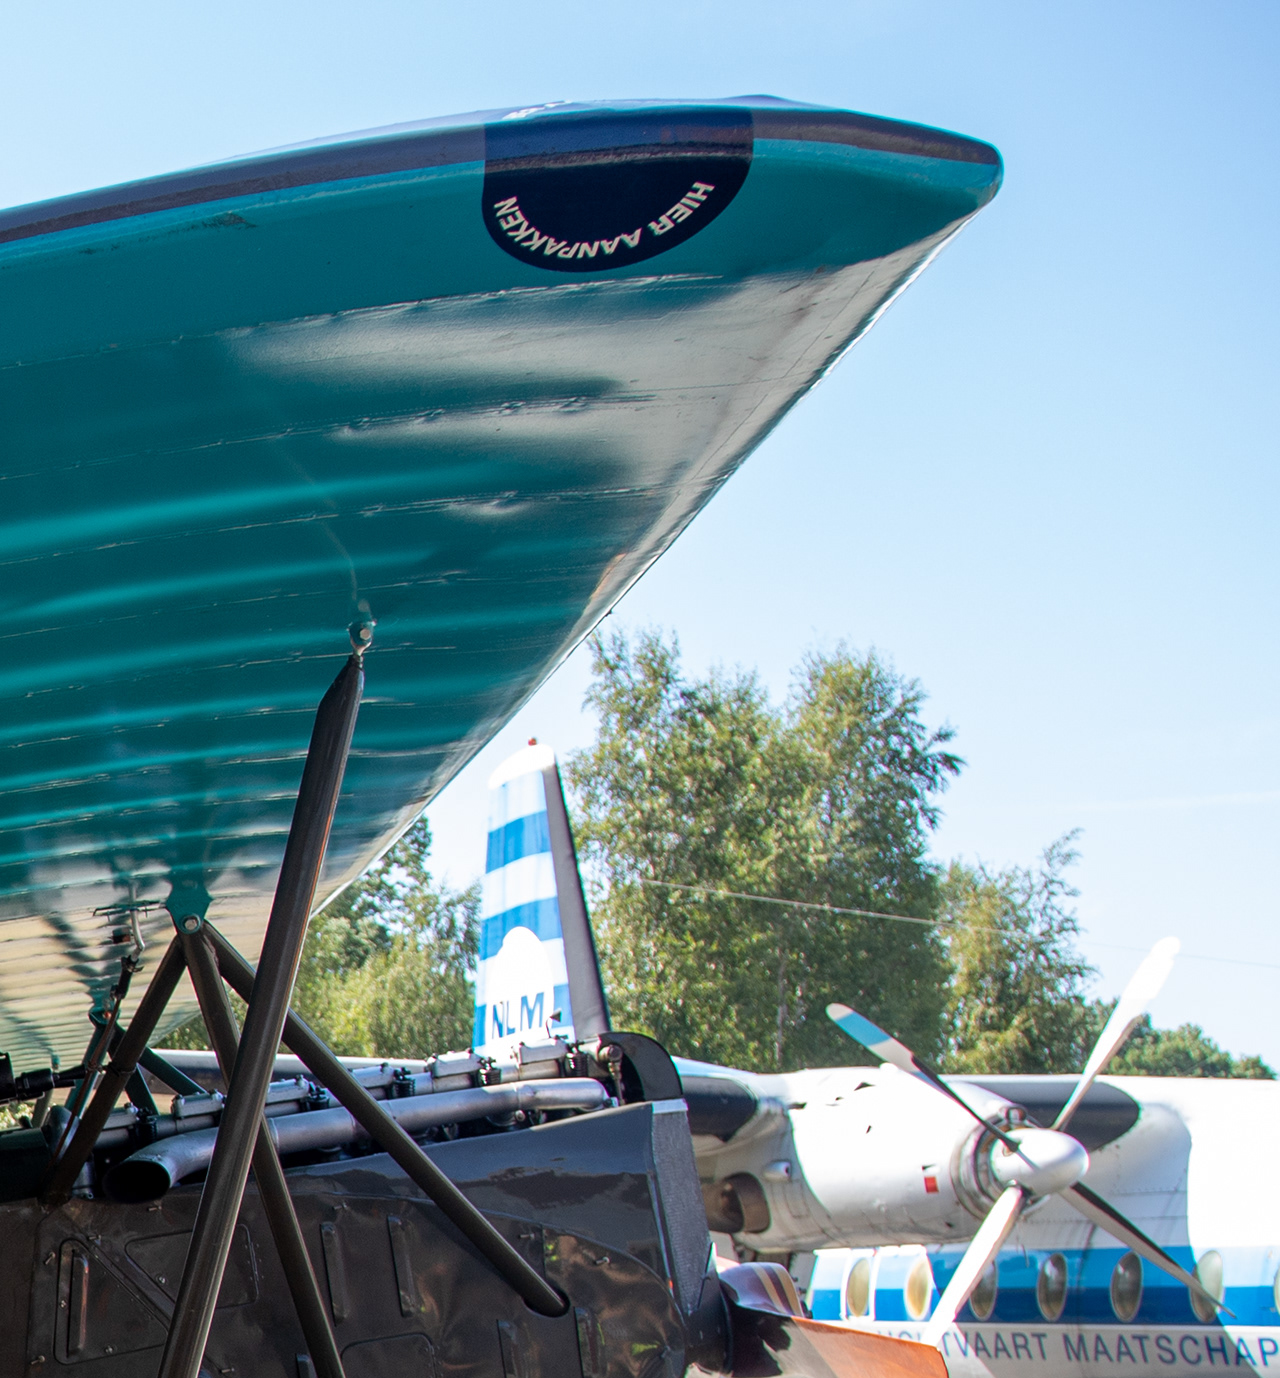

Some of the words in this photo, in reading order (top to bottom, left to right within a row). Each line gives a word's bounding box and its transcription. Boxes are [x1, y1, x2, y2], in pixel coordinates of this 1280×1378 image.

[493, 196, 643, 260] AANPAKKEN
[648, 181, 715, 236] HIER
[1062, 1332, 1279, 1367] MAATSCHAP
